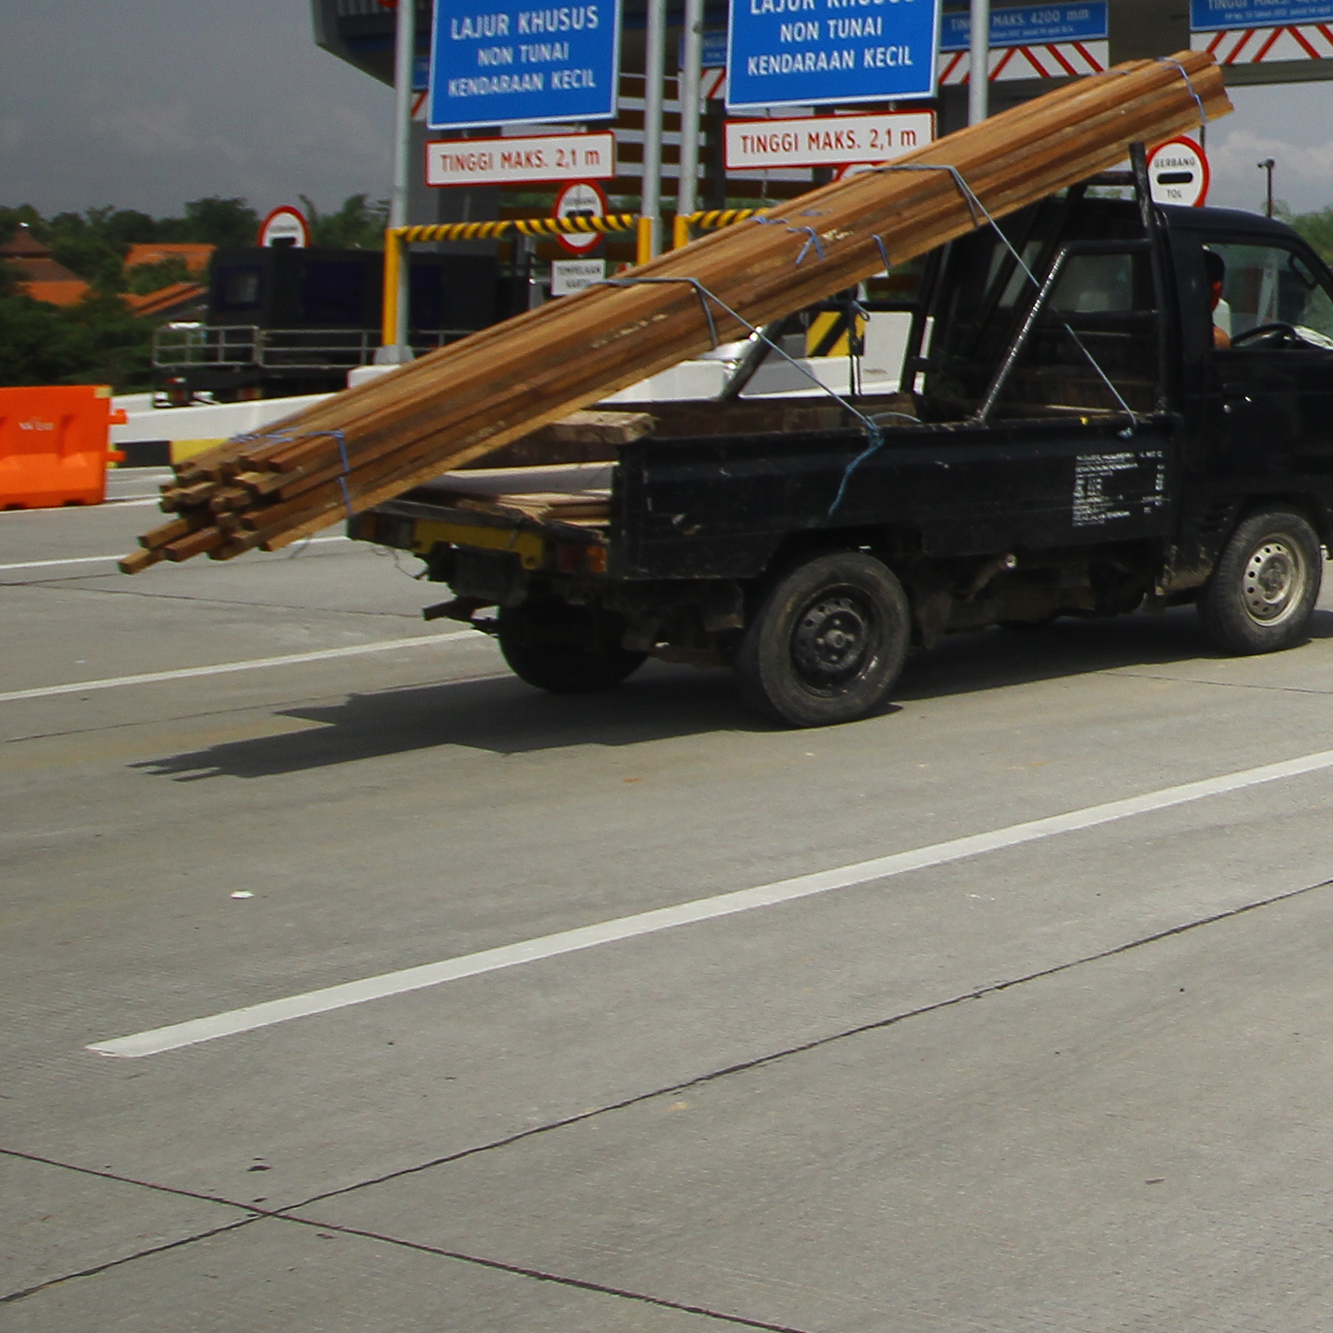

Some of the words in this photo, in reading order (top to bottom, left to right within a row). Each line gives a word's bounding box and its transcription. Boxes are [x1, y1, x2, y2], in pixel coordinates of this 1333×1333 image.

[451, 13, 509, 41] LAJUR
[518, 5, 599, 34] KHUSUS
[1030, 10, 1060, 24] 4200
[780, 22, 819, 42] NON
[827, 17, 882, 39] TUNAI
[477, 46, 513, 66] NON
[520, 42, 569, 63] TUNAI
[748, 50, 854, 76] KENDARAAN
[864, 46, 913, 68] KECIL
[449, 72, 544, 98] KENDARAAN
[552, 69, 596, 89] KECIL
[741, 133, 800, 154] TINGGI
[808, 130, 861, 151] MAKS.
[869, 128, 893, 151] 2,1
[900, 129, 917, 146] m
[441, 153, 494, 172] TINGGI
[501, 150, 548, 169] MAKS.
[555, 148, 577, 169] 2,1
[585, 149, 601, 165] m
[1154, 157, 1196, 168] GERBANG
[1166, 189, 1182, 199] TOL
